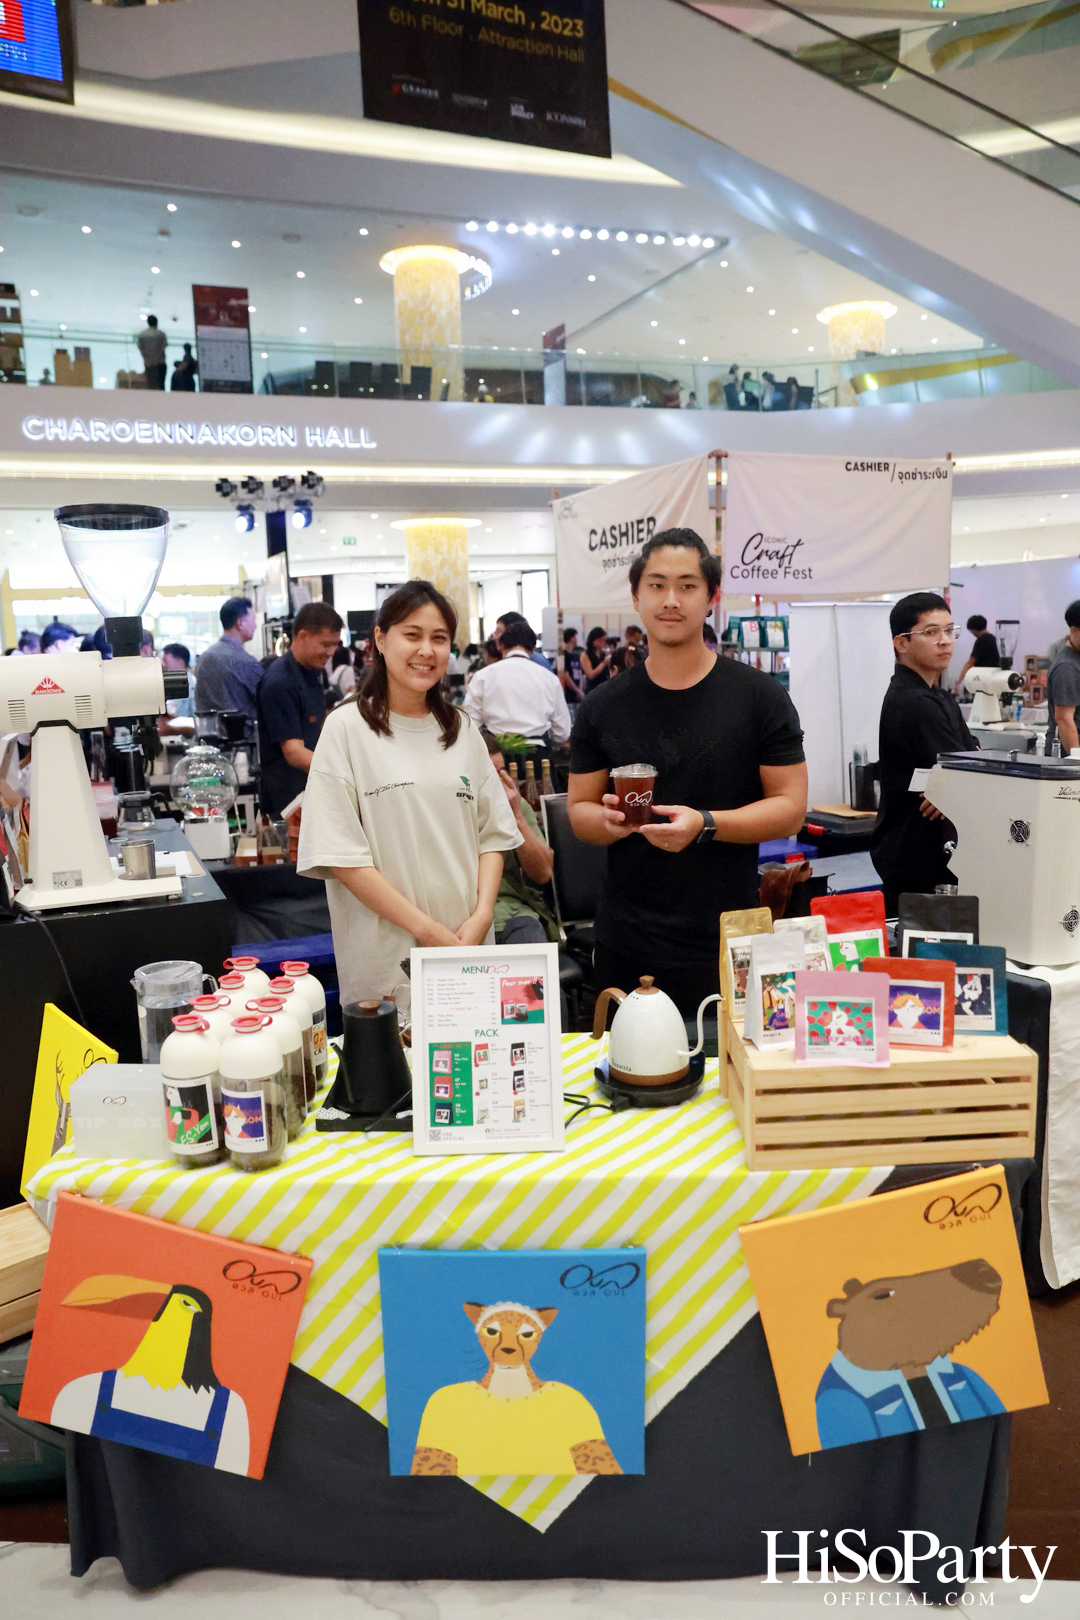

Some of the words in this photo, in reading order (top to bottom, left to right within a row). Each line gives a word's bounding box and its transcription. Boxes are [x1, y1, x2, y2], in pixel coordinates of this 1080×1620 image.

[389, 5, 417, 29] 6th
[421, 13, 464, 36] Floor
[477, 26, 554, 56] Attraction
[557, 44, 585, 63] Hall
[471, 0, 526, 27] March
[540, 10, 585, 38] 2023
[21, 414, 298, 448] CHAROENNAKORN
[304, 424, 378, 449] HALL
[844, 461, 890, 472] CASHIER
[588, 516, 657, 552] CASHIER
[741, 532, 805, 569] Craft
[730, 565, 779, 580] Coffee
[783, 566, 814, 580] Fest
[461, 966, 490, 974] MENU
[474, 1028, 499, 1037] PACK
